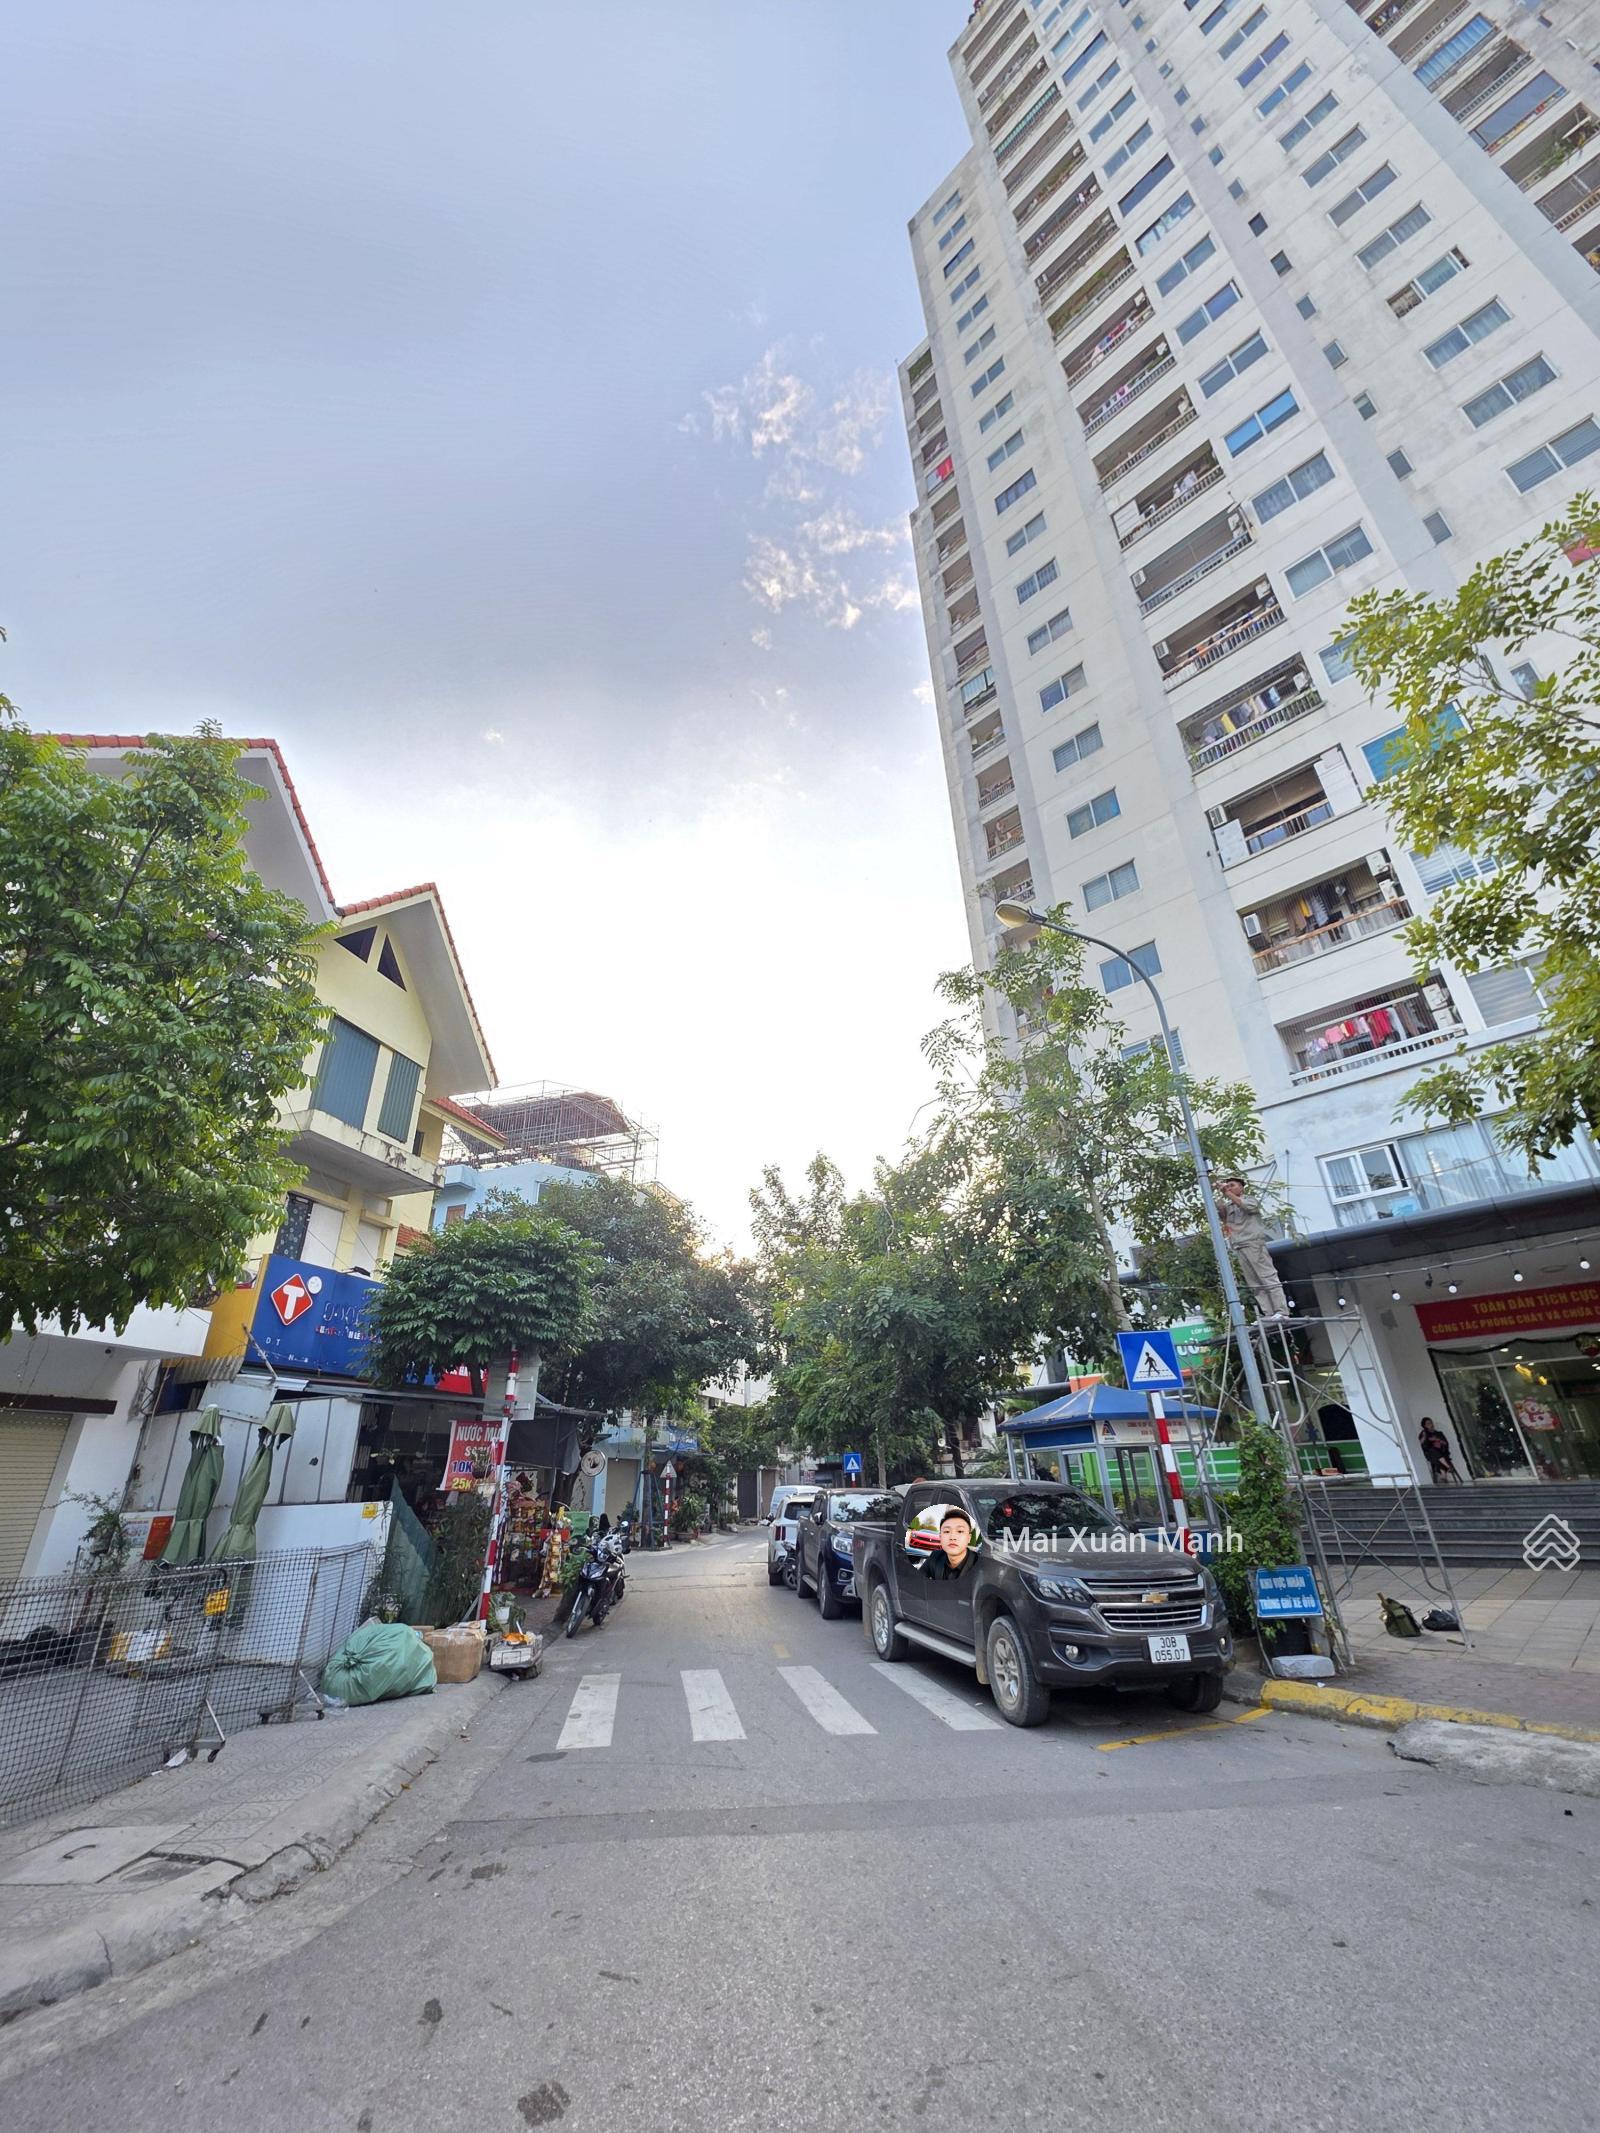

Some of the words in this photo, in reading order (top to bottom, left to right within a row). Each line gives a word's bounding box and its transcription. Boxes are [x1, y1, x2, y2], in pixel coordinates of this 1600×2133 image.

[1472, 1299, 1506, 1315] TOÀN
[1507, 1294, 1536, 1310] DÂN
[1539, 1290, 1568, 1307] TÍCH
[1570, 1288, 1600, 1304] CỰC
[1431, 1321, 1458, 1335] CÔNG
[1459, 1318, 1479, 1331] TÁC
[1516, 1309, 1544, 1324] CHÁY
[1546, 1307, 1561, 1321] VÀ
[1562, 1303, 1593, 1319] CHỮA
[456, 1423, 483, 1442] NƯỚC
[452, 1460, 474, 1473] 10K
[1159, 1637, 1177, 1649] 30B
[1154, 1648, 1186, 1662] 055.07
